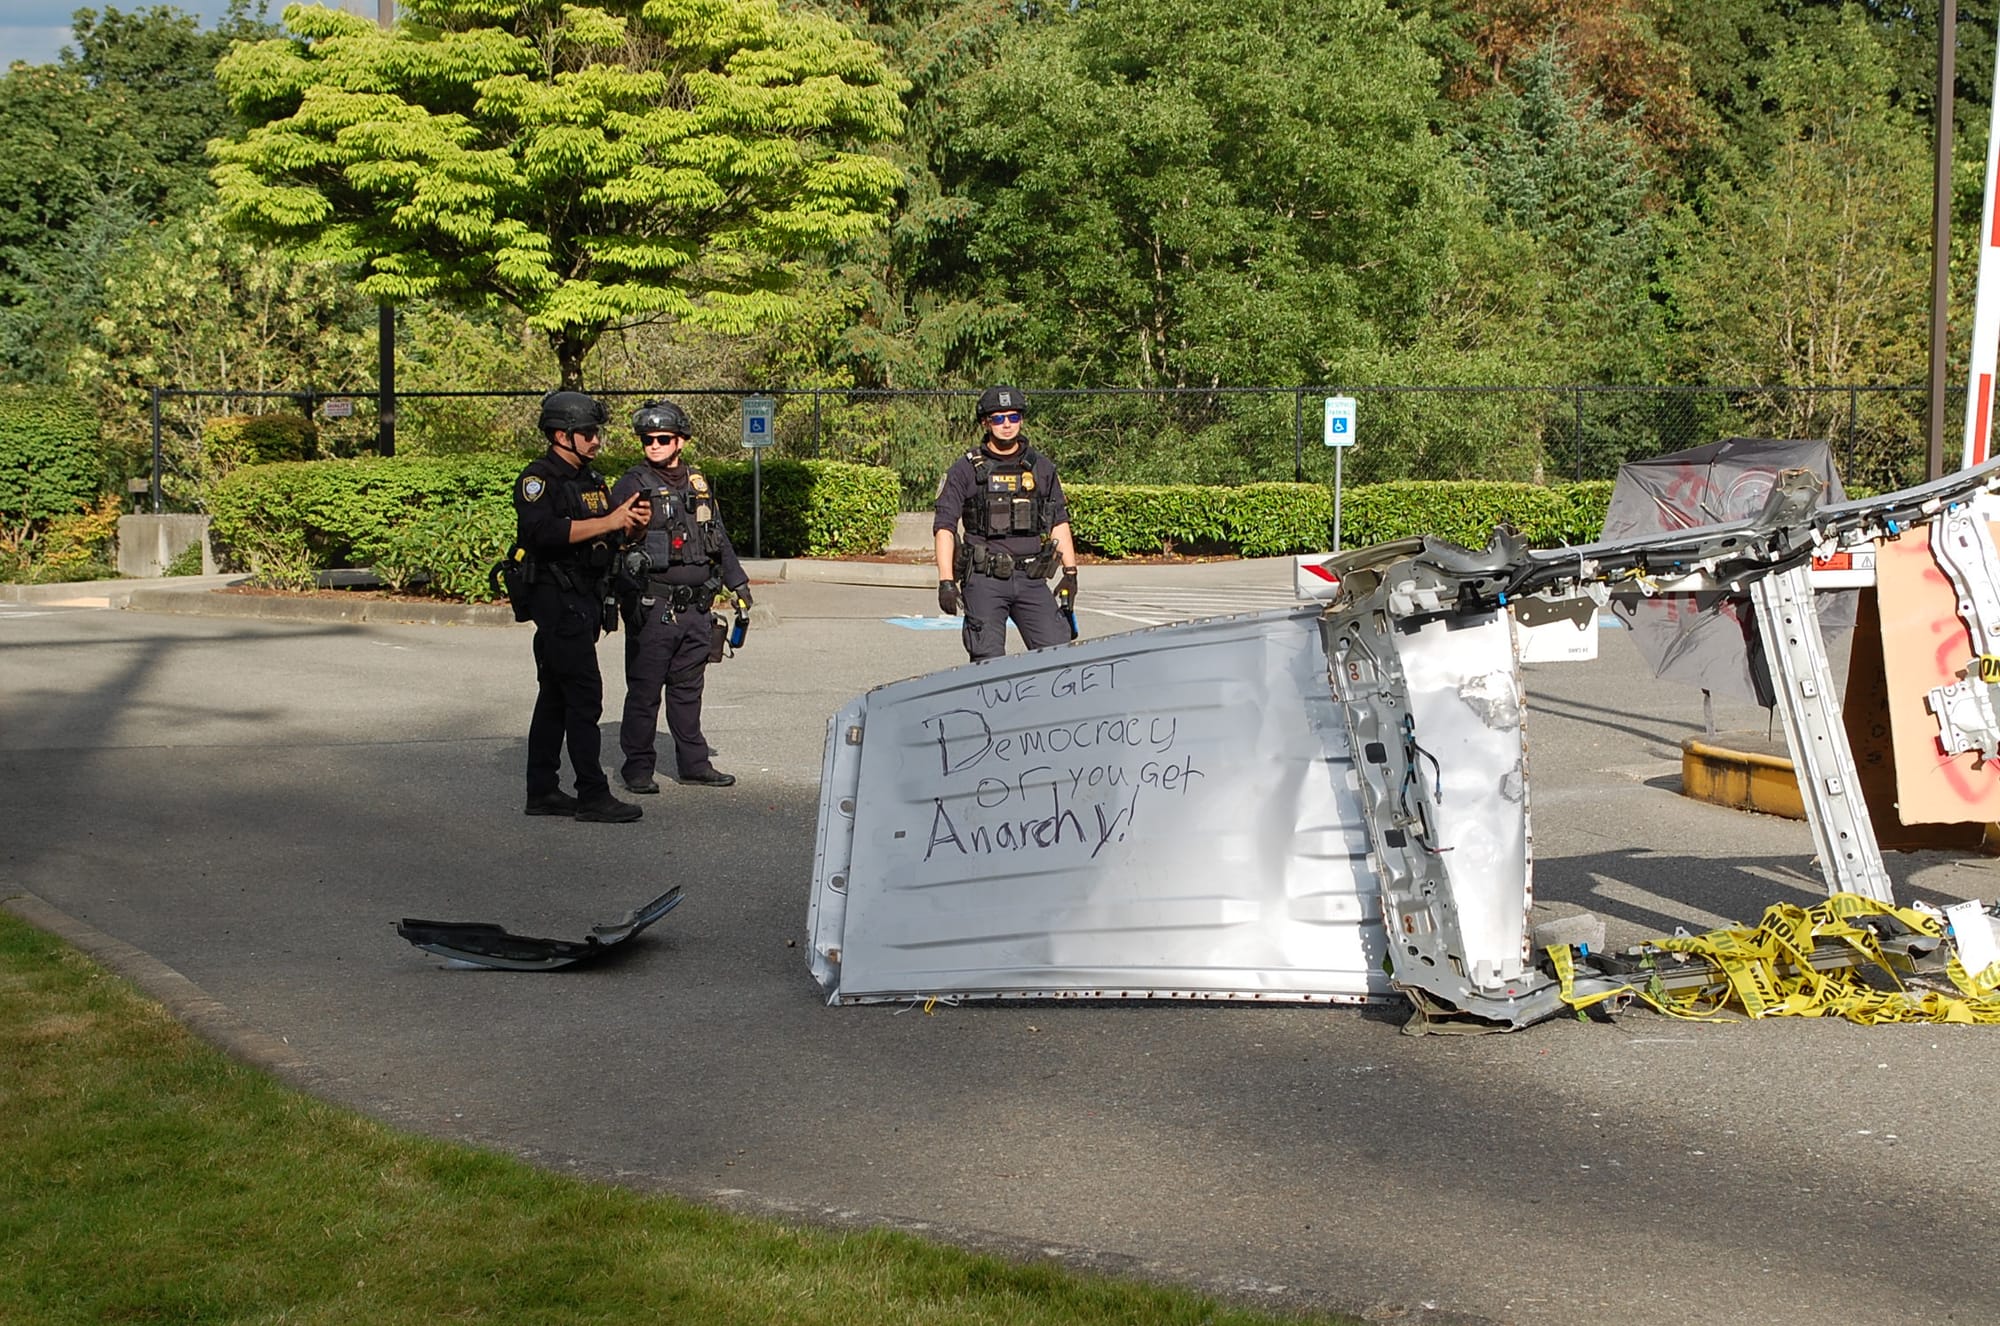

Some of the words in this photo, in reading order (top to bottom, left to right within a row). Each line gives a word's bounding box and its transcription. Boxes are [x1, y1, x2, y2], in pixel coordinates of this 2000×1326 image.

[977, 677, 1040, 709] WE
[1051, 659, 1131, 698] GET
[921, 709, 1177, 776] Democracy
[1068, 764, 1128, 798] you
[922, 781, 1140, 862] Anarchy!
